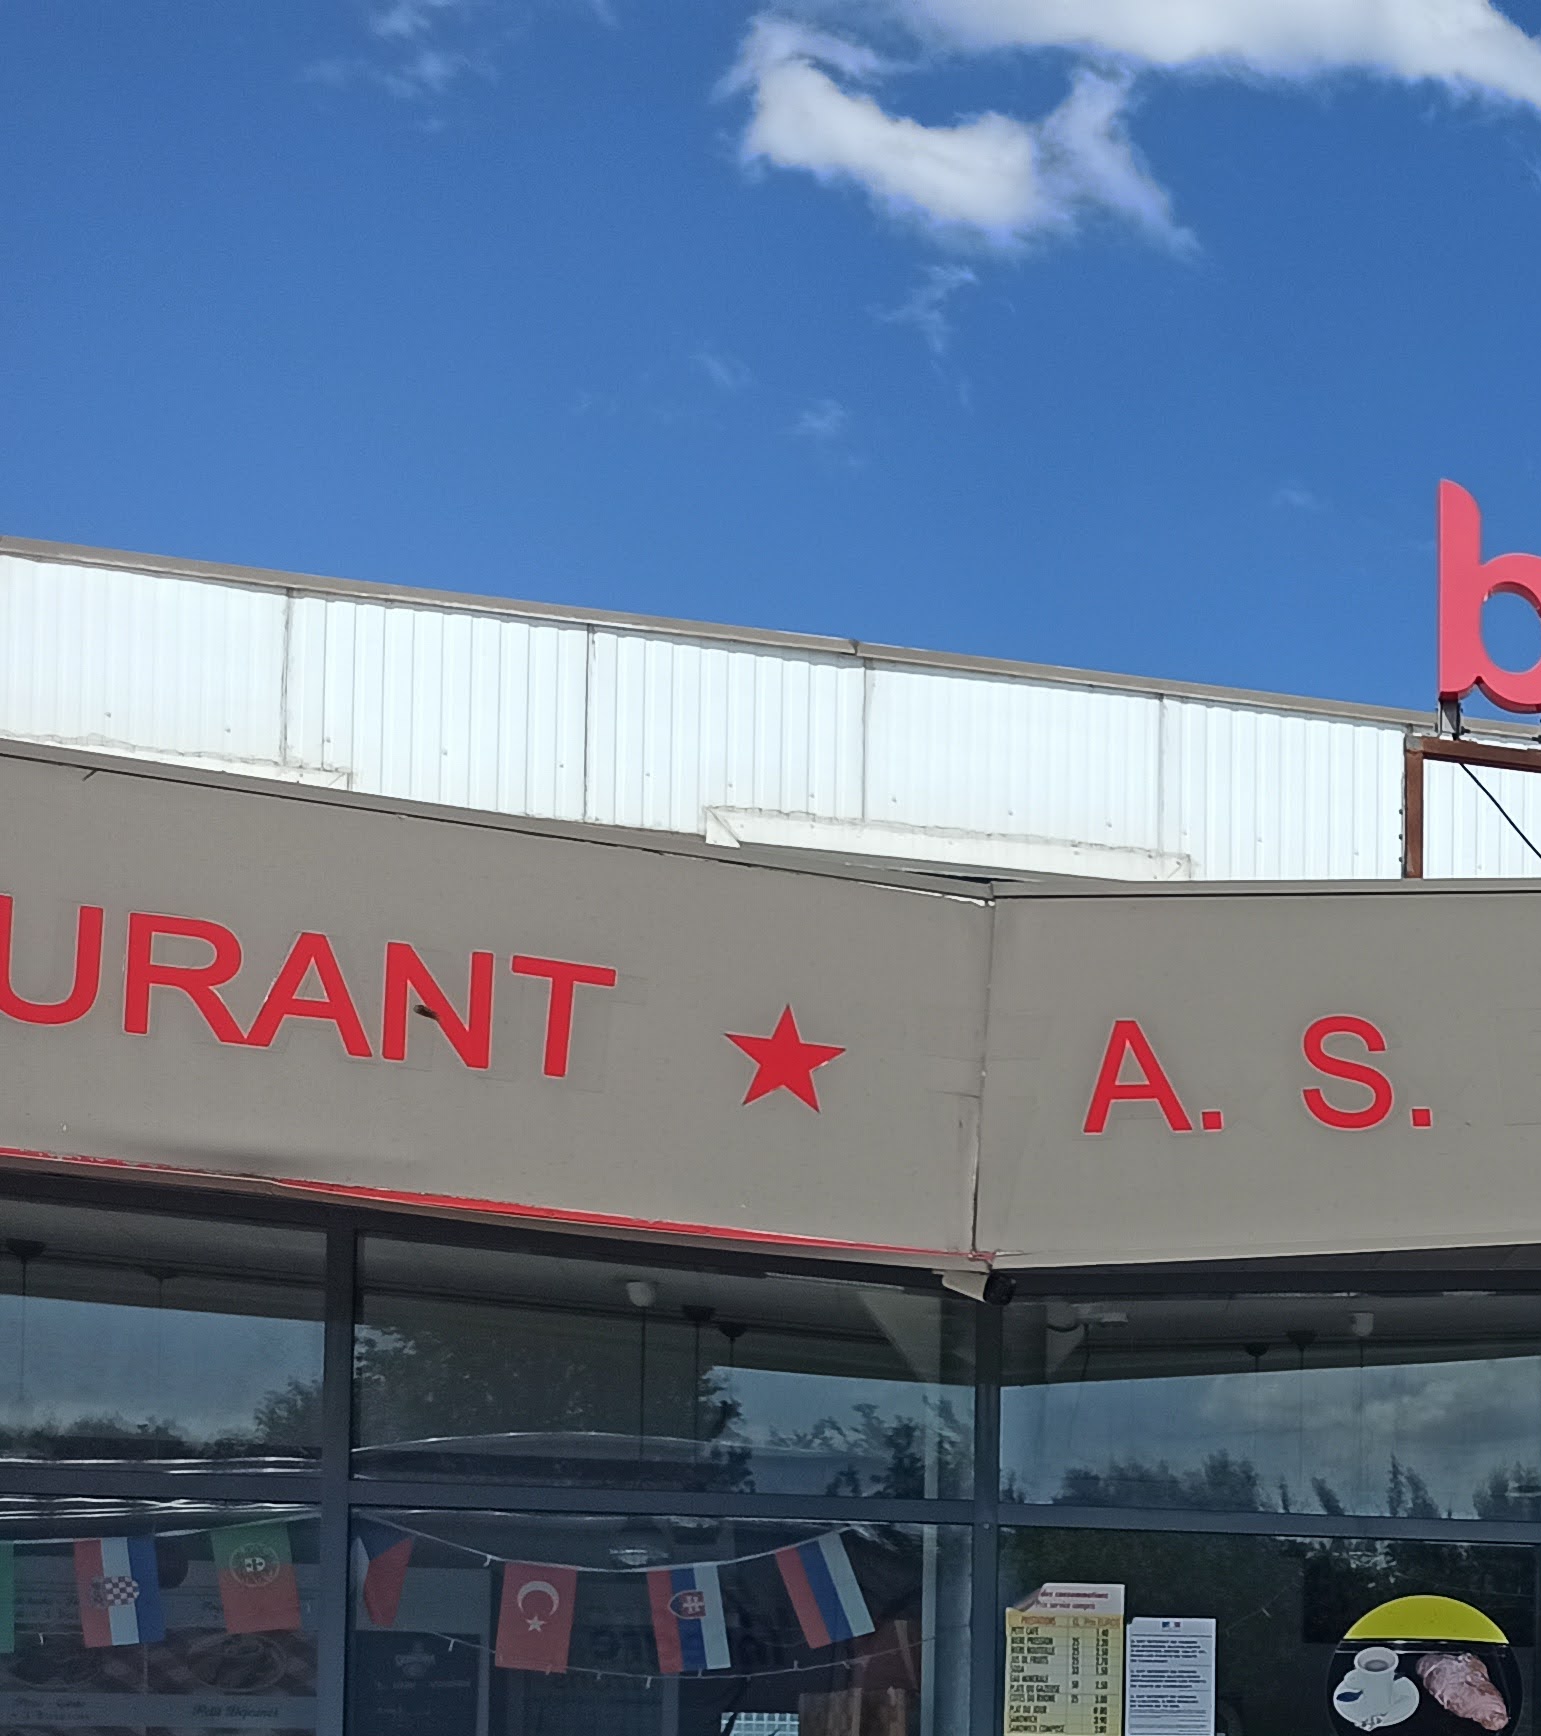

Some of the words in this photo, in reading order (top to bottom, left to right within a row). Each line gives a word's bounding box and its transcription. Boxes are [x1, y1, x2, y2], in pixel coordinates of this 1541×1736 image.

[0, 894, 617, 1078] URANT
[1084, 1020, 1224, 1135] A.
[1302, 1015, 1432, 1131] S.
